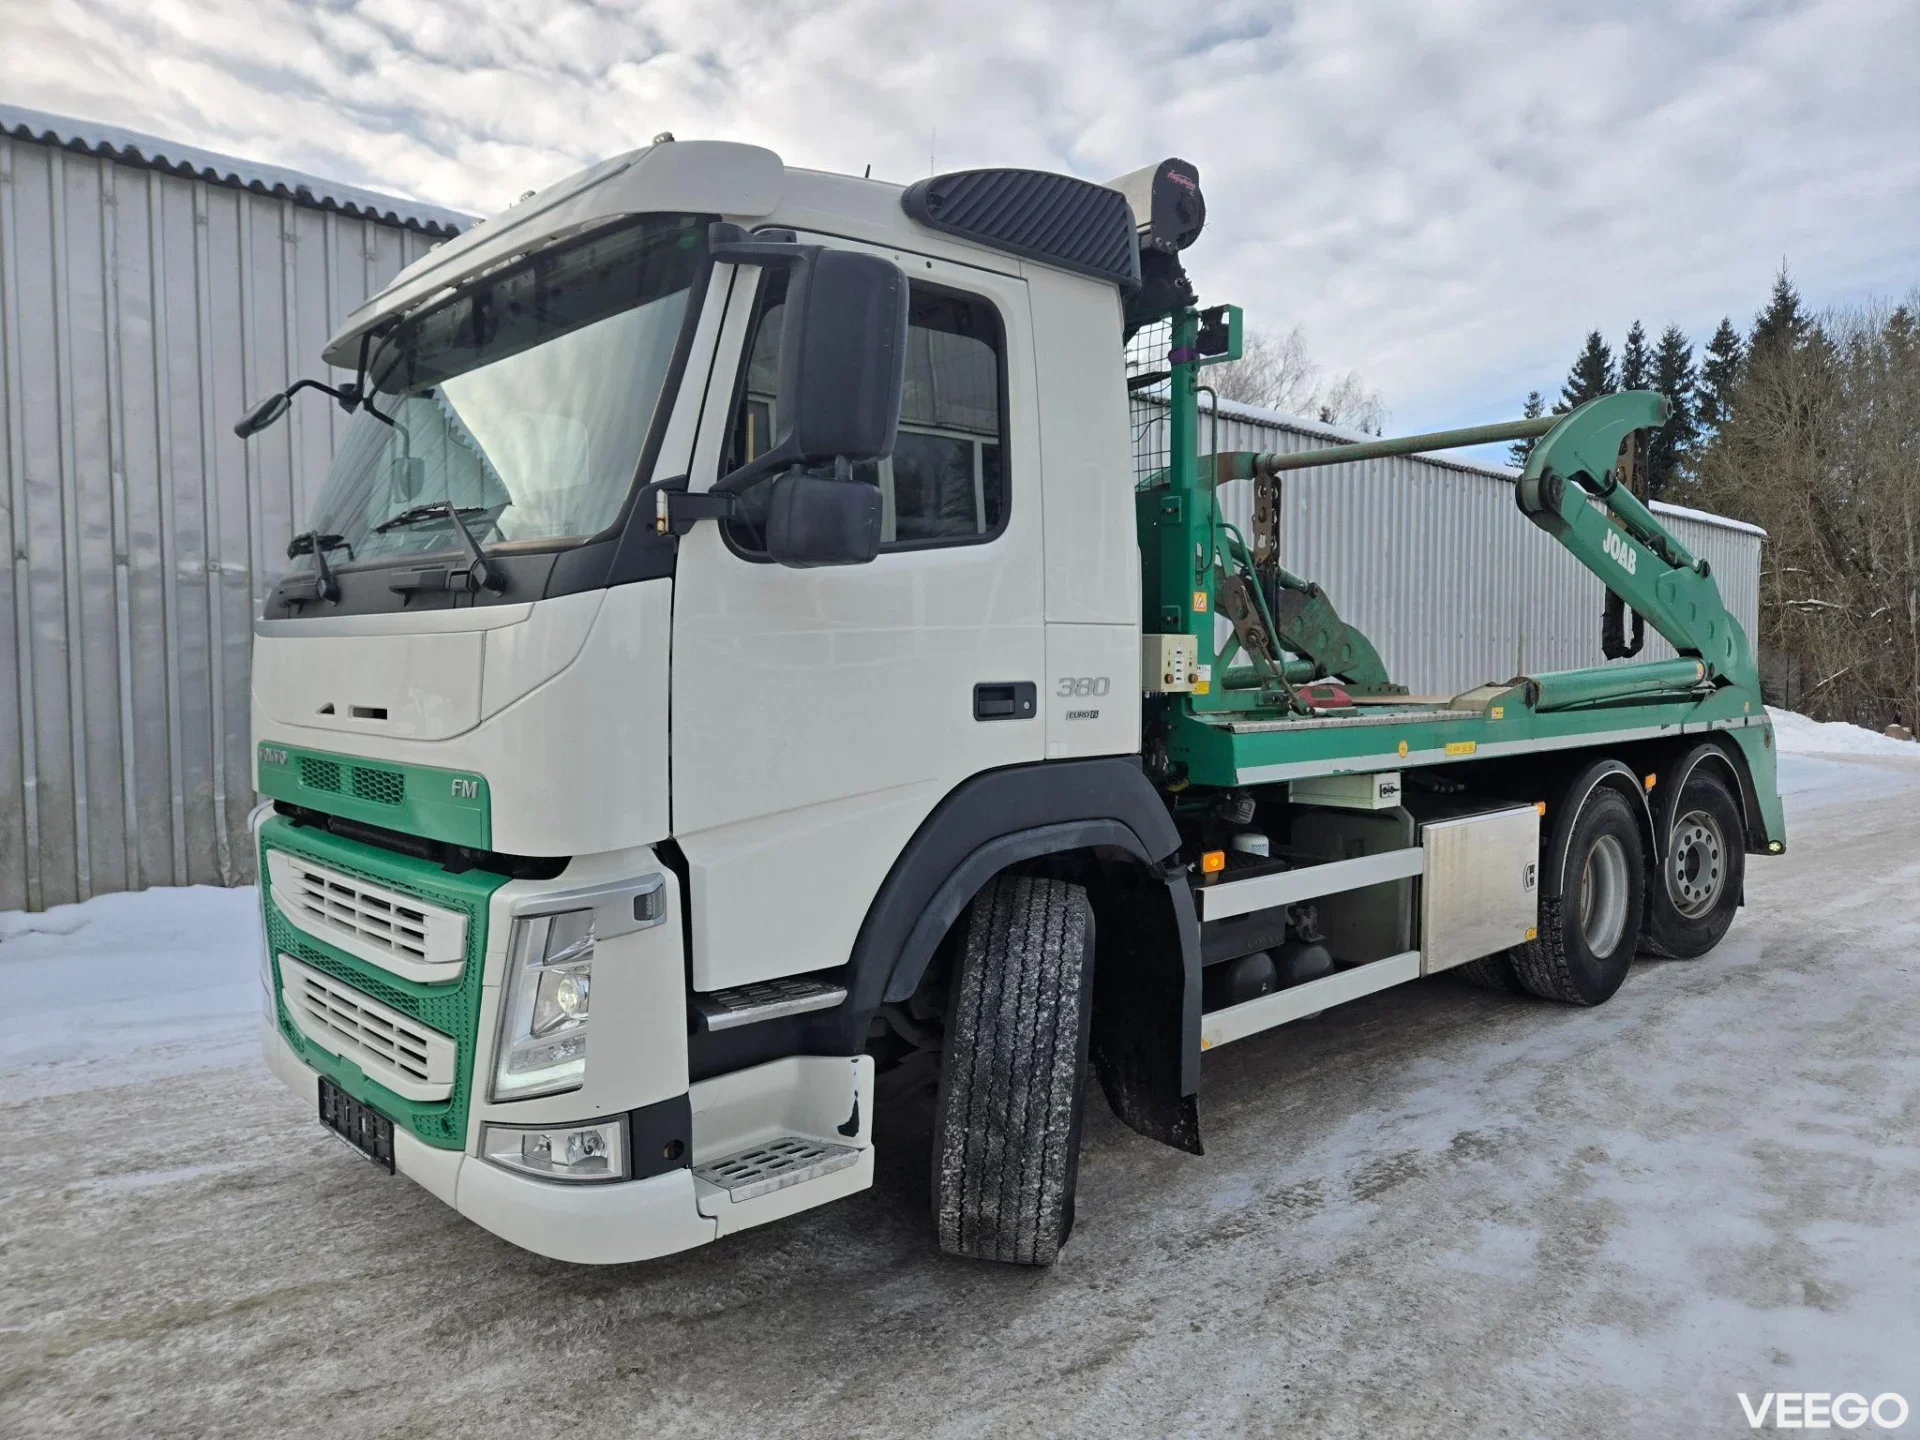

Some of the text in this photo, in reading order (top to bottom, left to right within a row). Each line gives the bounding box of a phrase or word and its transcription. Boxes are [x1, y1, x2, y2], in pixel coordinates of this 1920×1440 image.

[1602, 527, 1637, 575] JOAB
[1056, 677, 1110, 697] 380
[451, 779, 478, 799] FM
